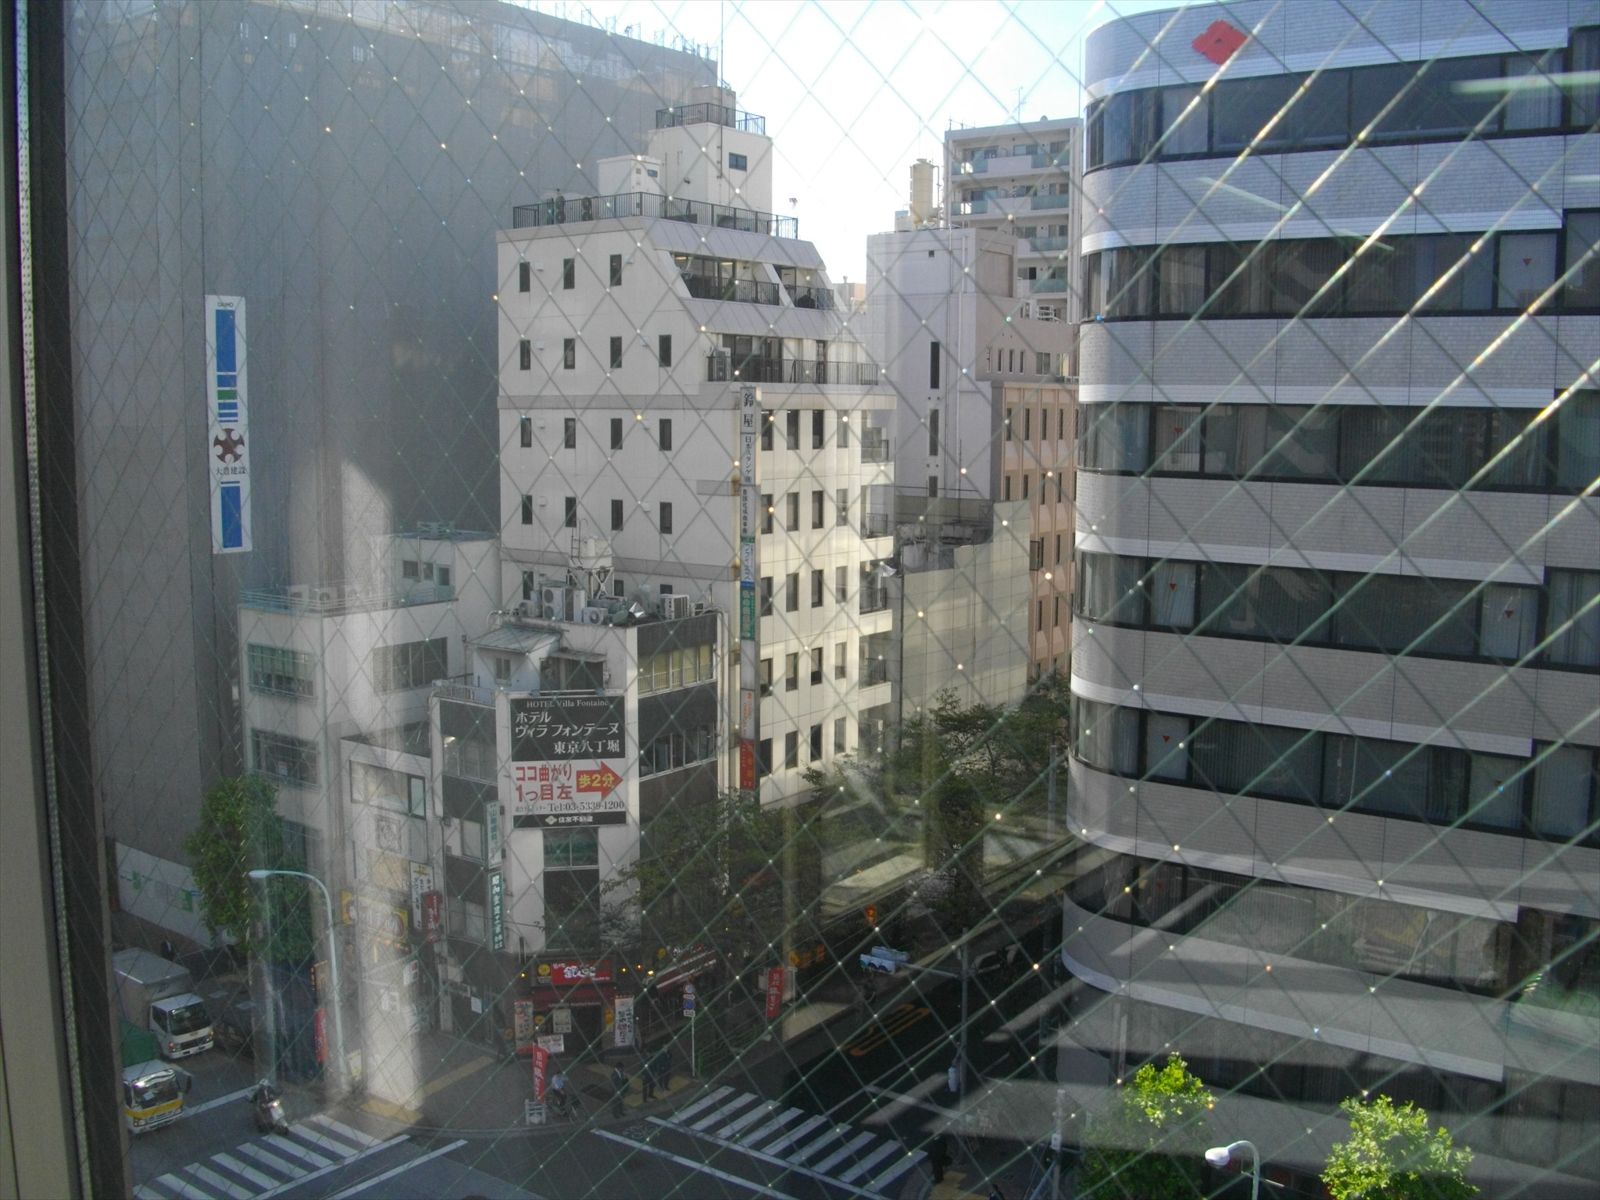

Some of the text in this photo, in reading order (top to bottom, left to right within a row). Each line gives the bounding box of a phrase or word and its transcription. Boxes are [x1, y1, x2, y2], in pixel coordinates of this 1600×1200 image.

[743, 391, 754, 428] 鈴屋
[526, 698, 609, 708] HOTEL Villa Fontaine
[515, 711, 552, 724] ホテル
[554, 739, 620, 754] 東京八丁堀
[515, 763, 573, 782] ココ曲がり
[578, 772, 615, 788] 歩2分
